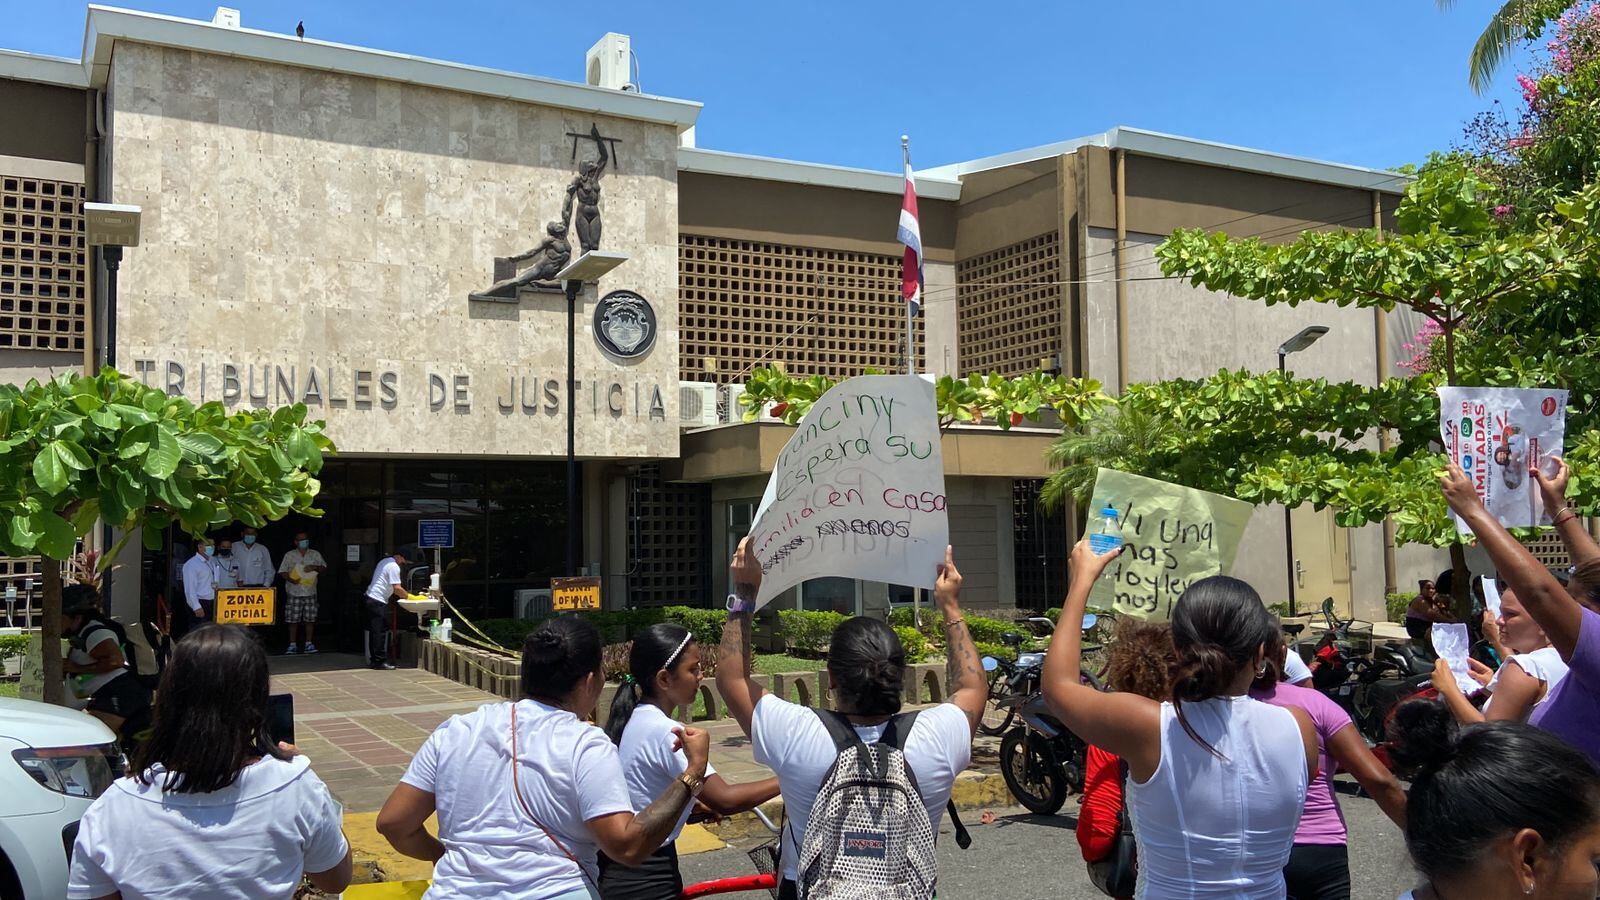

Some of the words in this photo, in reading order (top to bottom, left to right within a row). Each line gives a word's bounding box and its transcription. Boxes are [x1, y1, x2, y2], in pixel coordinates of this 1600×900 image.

[134, 359, 398, 408] TRIBUNALES
[429, 373, 470, 411] DE
[828, 487, 865, 508] en
[226, 594, 265, 605] ZONA
[224, 608, 268, 619] OFICIAL
